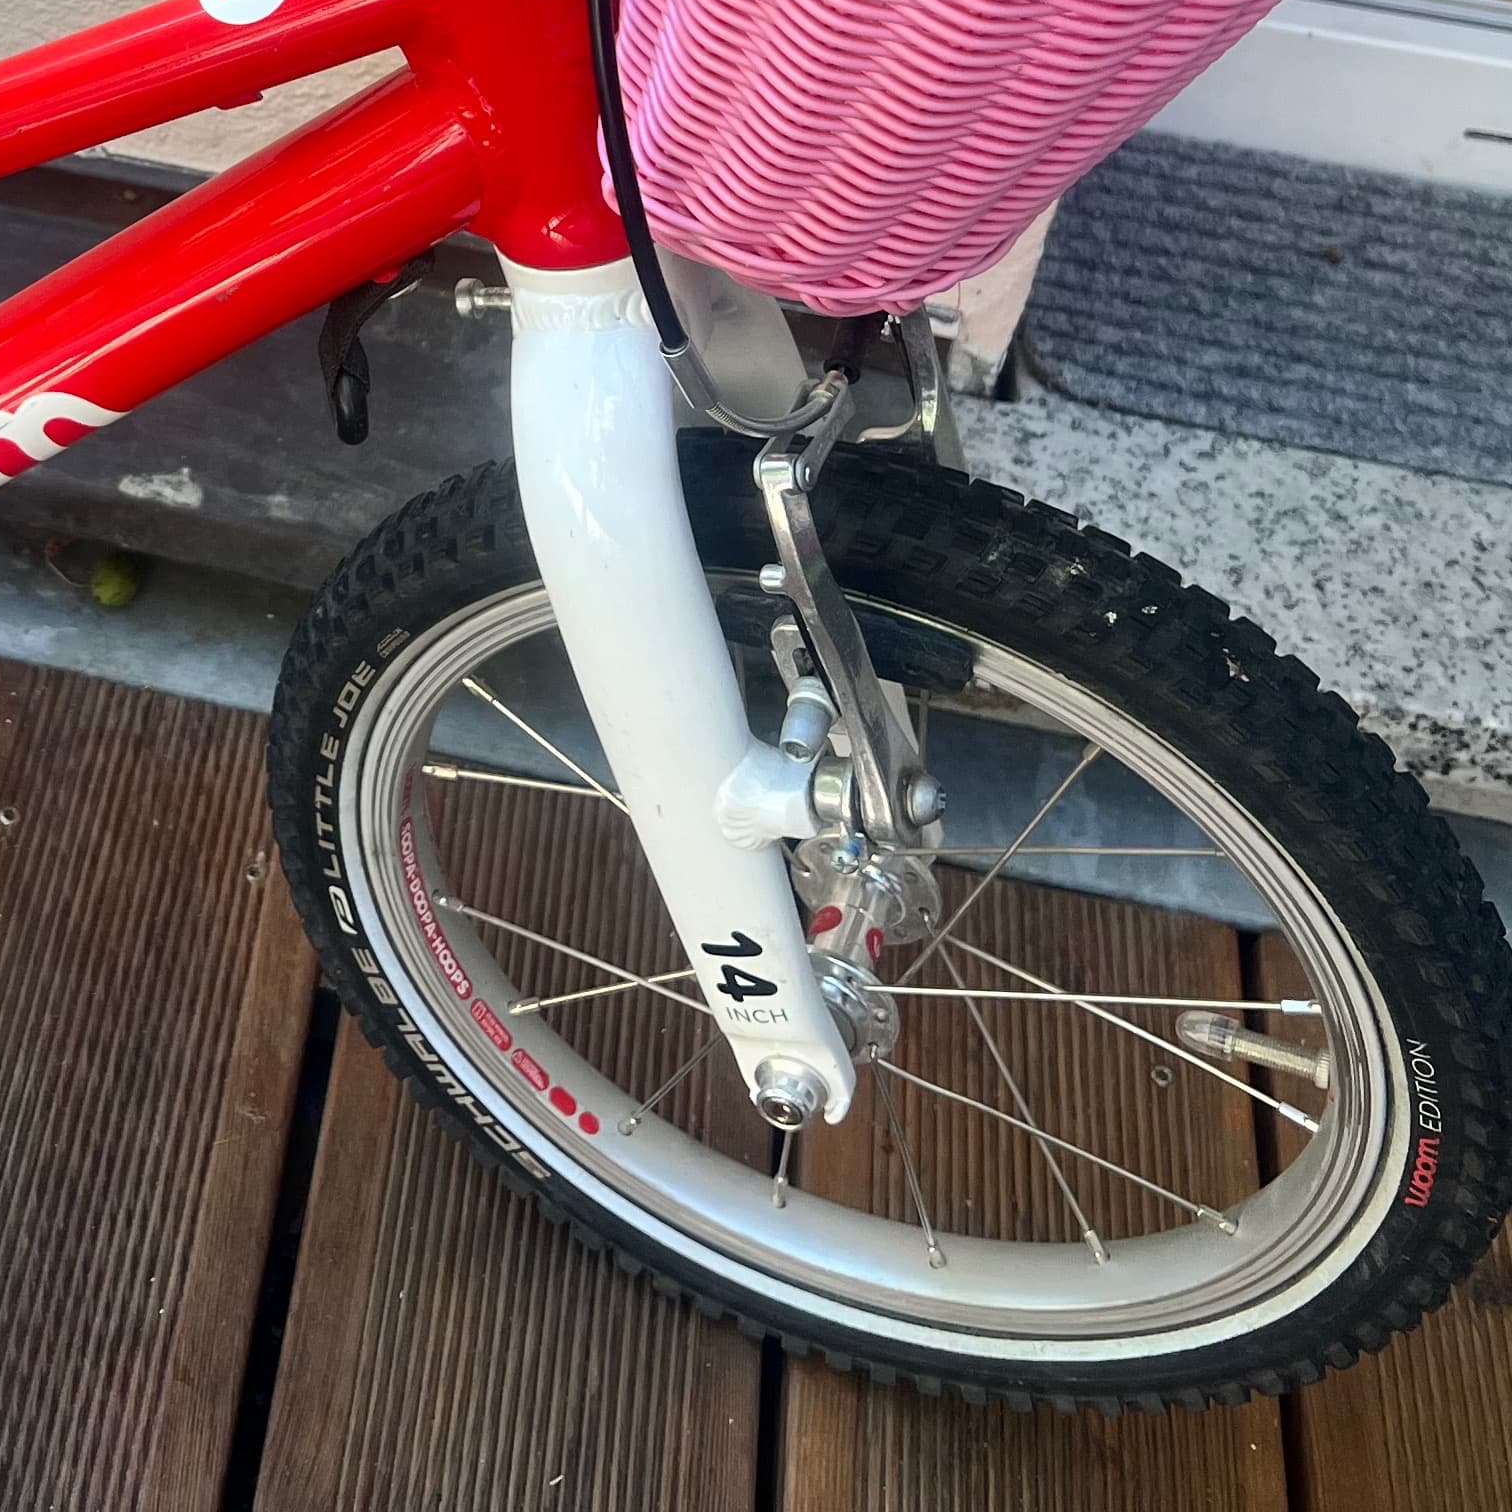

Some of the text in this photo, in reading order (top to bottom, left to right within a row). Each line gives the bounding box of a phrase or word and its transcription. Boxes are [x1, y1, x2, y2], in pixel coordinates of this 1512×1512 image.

[332, 660, 376, 729] JOE
[315, 732, 342, 879] LITTLE
[701, 931, 778, 1002] 14
[726, 1007, 789, 1024] INCH
[352, 948, 551, 1178] SCHWALBE
[1404, 1038, 1442, 1208] woom EDITION
